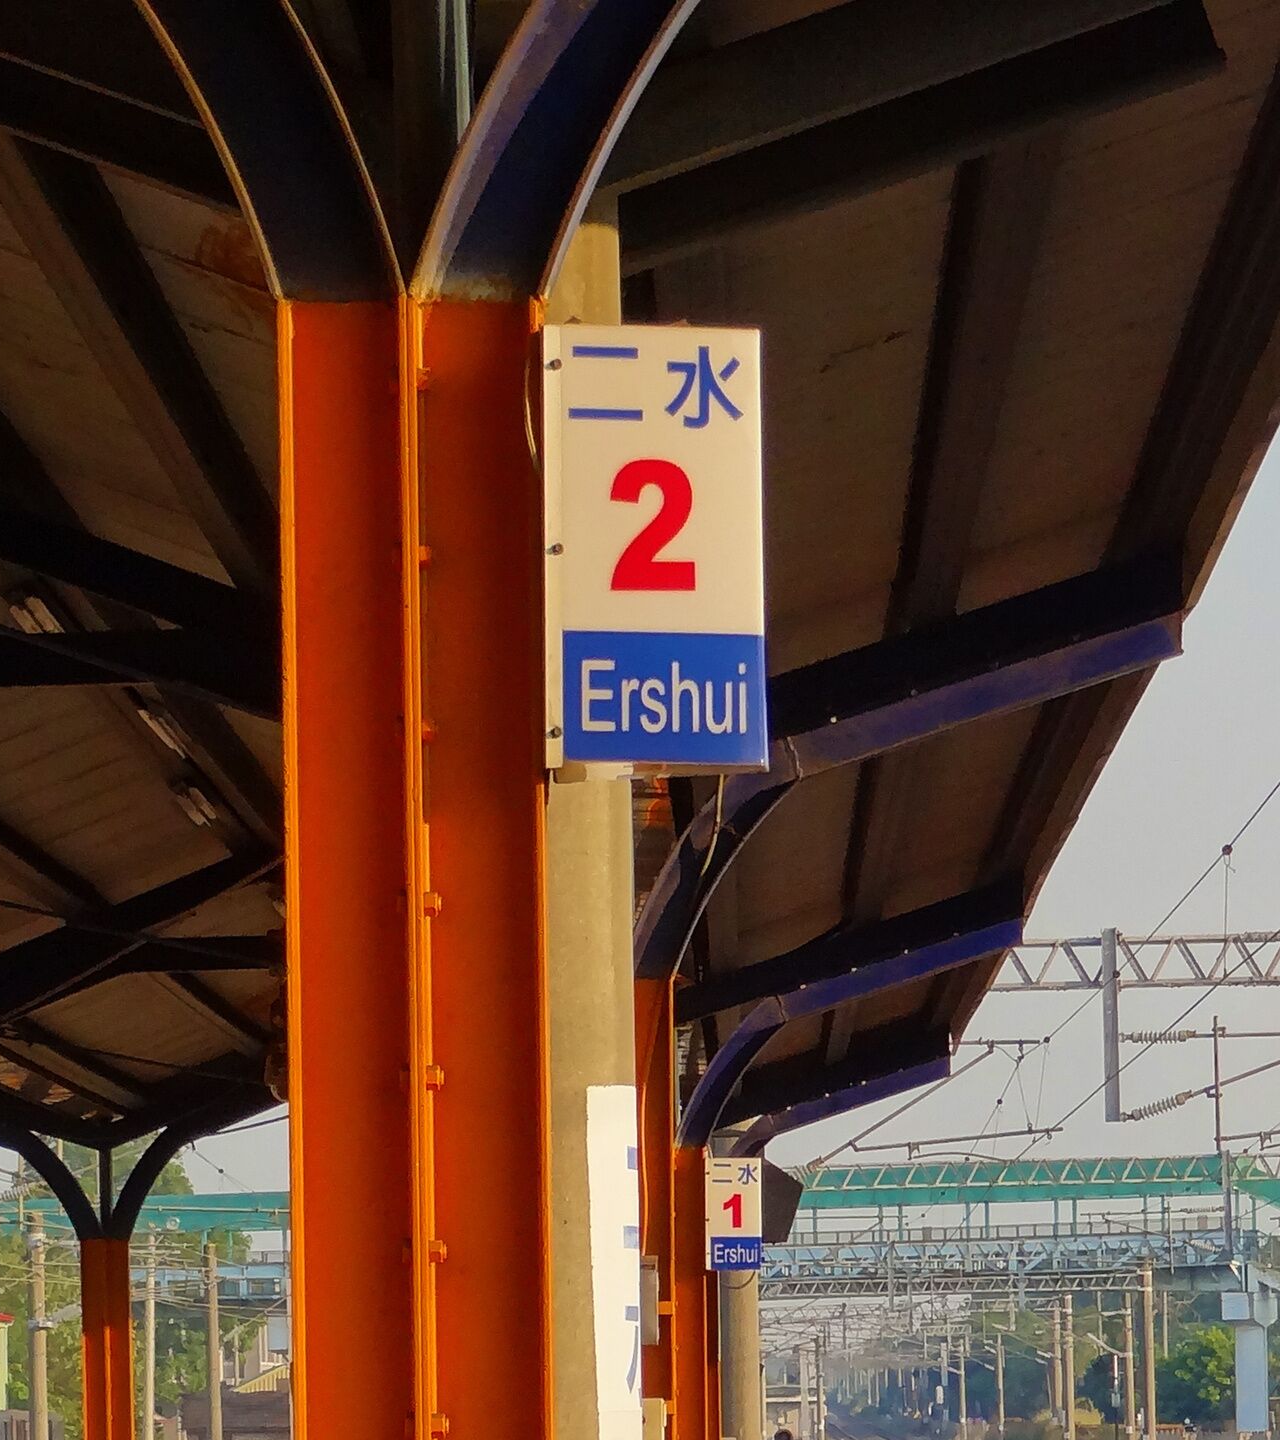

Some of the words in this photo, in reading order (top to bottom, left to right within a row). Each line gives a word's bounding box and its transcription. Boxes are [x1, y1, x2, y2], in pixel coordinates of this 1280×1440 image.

[568, 344, 745, 430] 二水
[608, 457, 697, 592] 2
[579, 657, 749, 736] Ershui
[711, 1162, 758, 1186] 二水
[722, 1192, 743, 1229] 1
[713, 1242, 759, 1265] Ershui
